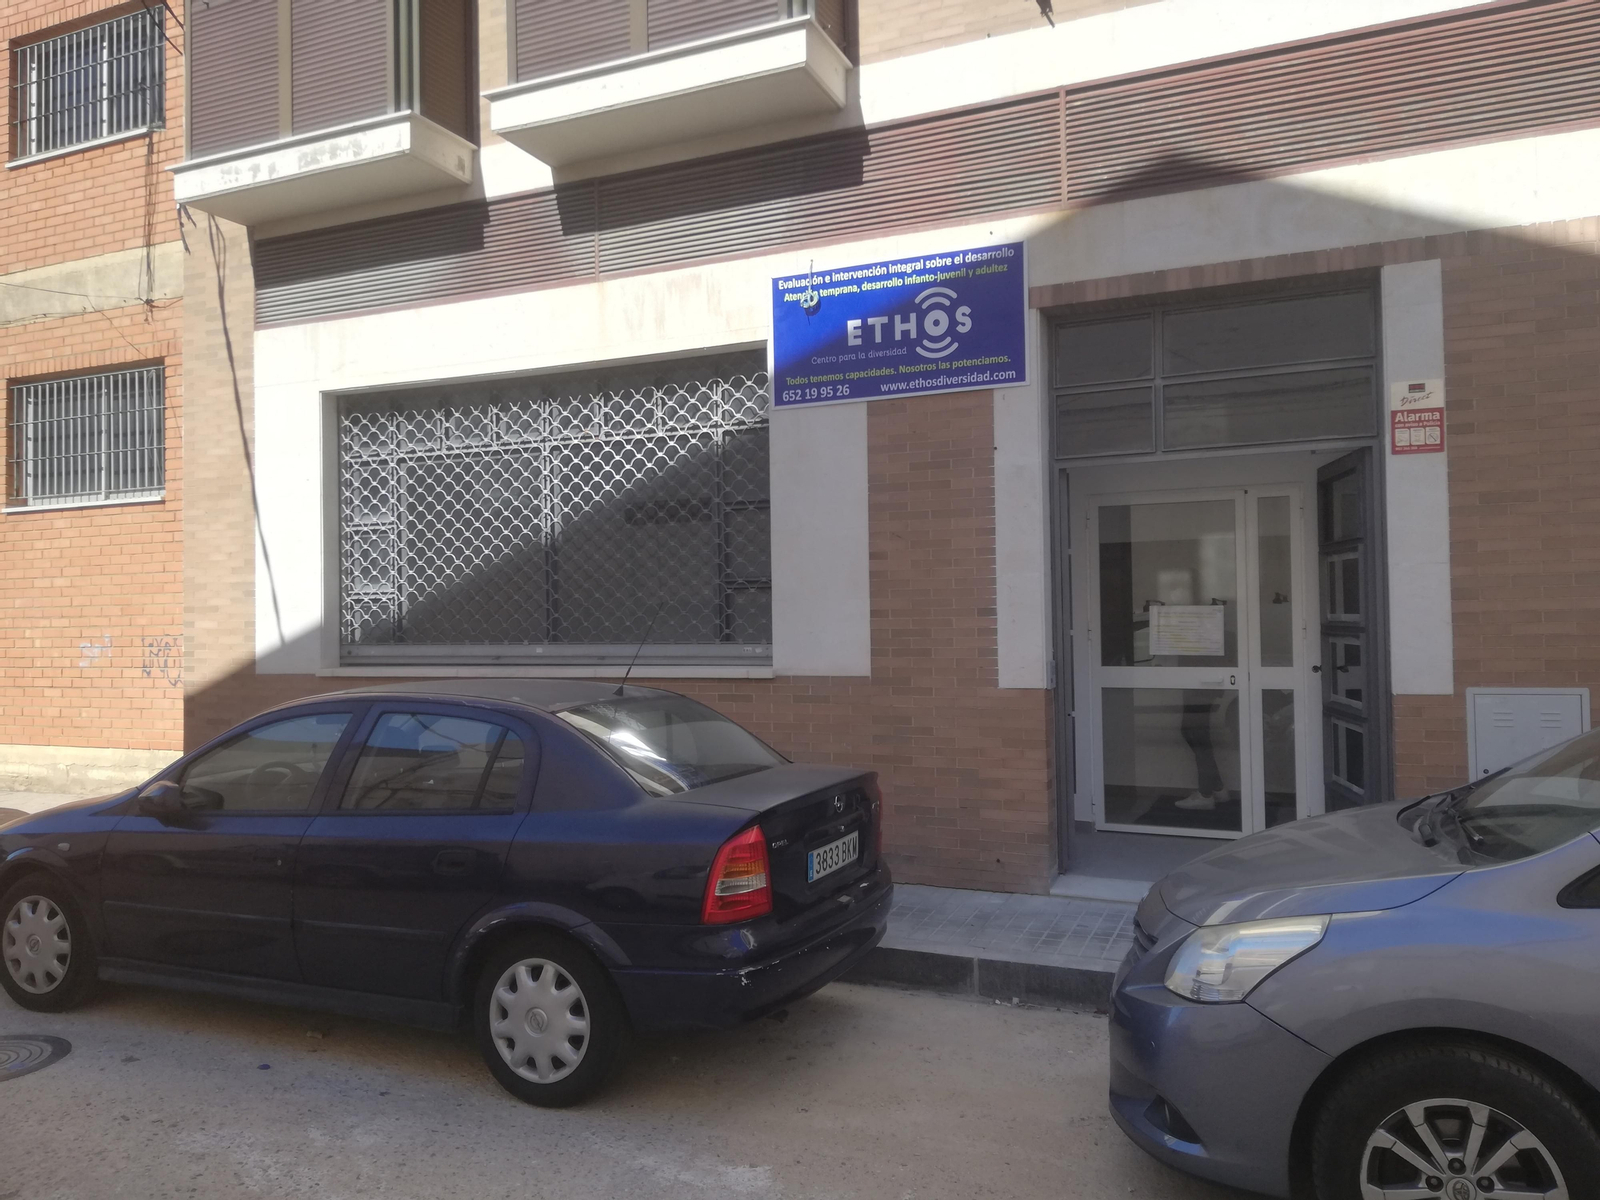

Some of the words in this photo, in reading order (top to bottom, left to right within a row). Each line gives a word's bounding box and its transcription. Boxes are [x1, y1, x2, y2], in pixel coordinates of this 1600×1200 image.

[832, 265, 887, 282] intervención
[888, 259, 924, 274] integral
[925, 257, 952, 269] sobre
[954, 253, 963, 265] el
[965, 247, 1015, 263] desarrollo
[819, 284, 860, 297] temprana,
[861, 277, 903, 291] desarrollo
[904, 268, 966, 285] infanto-juvenil
[968, 268, 974, 278] y
[975, 264, 1008, 275] adultez
[846, 305, 973, 347] ETHOS
[785, 377, 809, 386] Todos
[810, 374, 844, 383] tenemos
[845, 366, 897, 380] capacidades.
[898, 363, 937, 374] Nosotros
[938, 360, 951, 370] las
[952, 354, 1011, 370] potenciamos.
[811, 355, 837, 365] Centro
[838, 354, 856, 364] para
[858, 351, 866, 359] la
[868, 346, 907, 358] diversidad
[782, 389, 802, 402] 652
[804, 387, 818, 400] 19
[820, 386, 834, 398] 95
[836, 384, 850, 396] 26
[880, 370, 1016, 392] www.ethosdiversidad.com
[1394, 411, 1441, 423] Alarma
[815, 845, 840, 875] 3833
